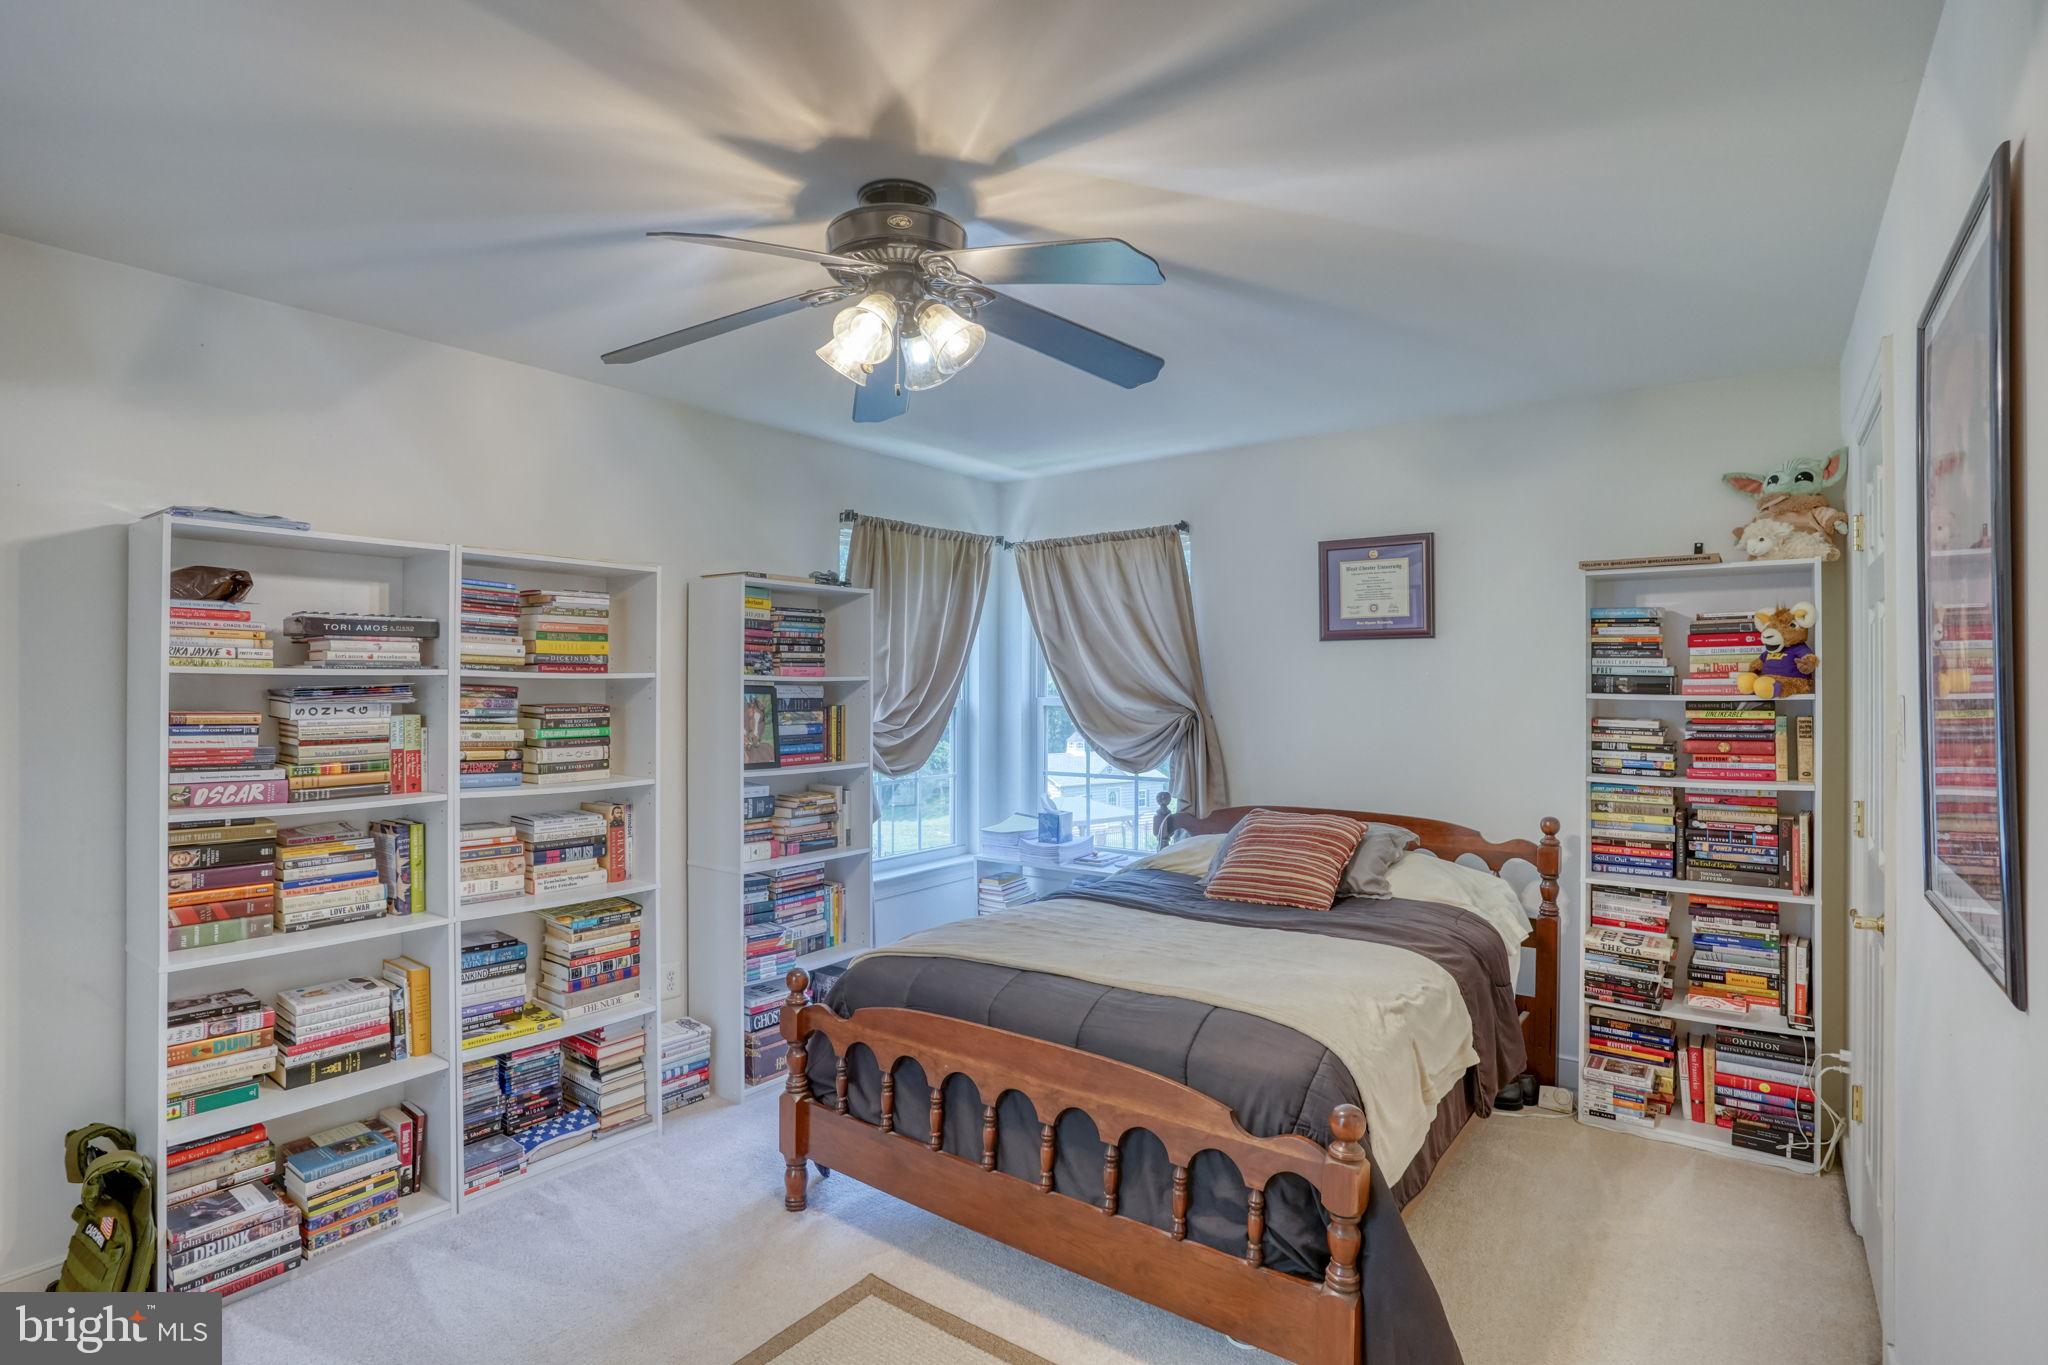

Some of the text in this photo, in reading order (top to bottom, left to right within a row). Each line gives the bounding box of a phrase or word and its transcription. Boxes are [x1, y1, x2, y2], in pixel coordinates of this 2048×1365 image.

[324, 623, 351, 631] TORI
[190, 647, 222, 657] JAYNE
[1713, 662, 1739, 672] Daniel
[295, 706, 368, 716] SONTAG
[194, 784, 265, 806] OSCAR
[1626, 840, 1652, 848] Invasion
[566, 845, 593, 862] BACKLASH
[330, 907, 346, 916] LOVE
[356, 904, 370, 912] WAR
[1600, 943, 1622, 953] THE
[1624, 947, 1642, 956] CIA
[583, 996, 623, 1013] THE NUDE
[468, 1036, 492, 1046] UNIVERSAL
[514, 1026, 534, 1036] MONSTERS
[1721, 1046, 1743, 1055] BRITNEY
[1718, 1087, 1762, 1101] RUSH LIMBAUGH
[193, 1229, 250, 1261] DRUNK
